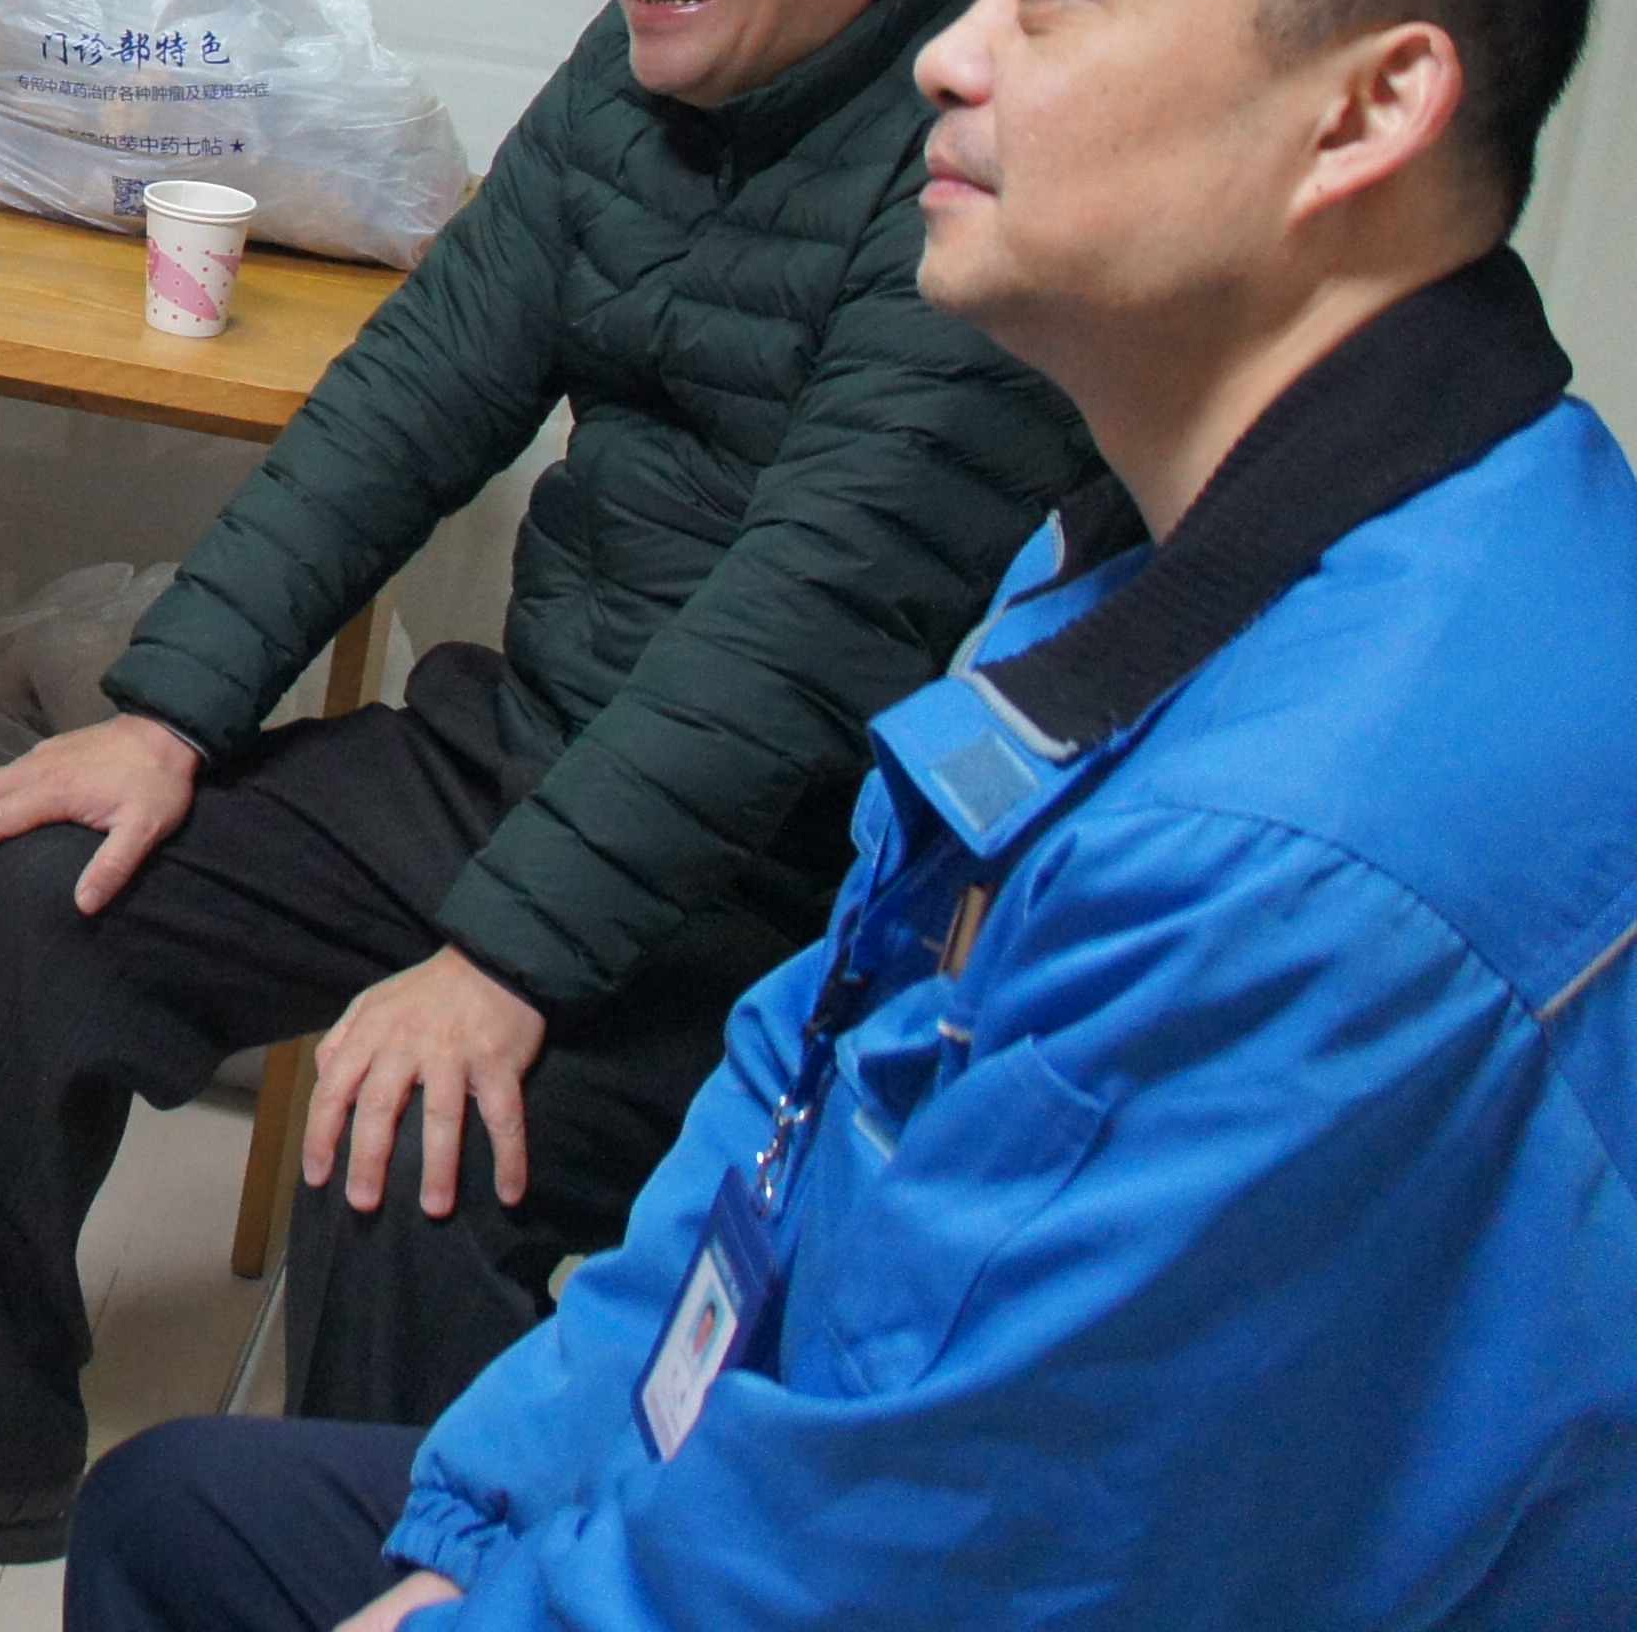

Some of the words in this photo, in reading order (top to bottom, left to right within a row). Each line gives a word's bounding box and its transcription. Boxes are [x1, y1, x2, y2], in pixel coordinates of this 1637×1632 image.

[41, 29, 231, 69] 门诊部特色
[67, 128, 223, 157] 内装中药七帖
